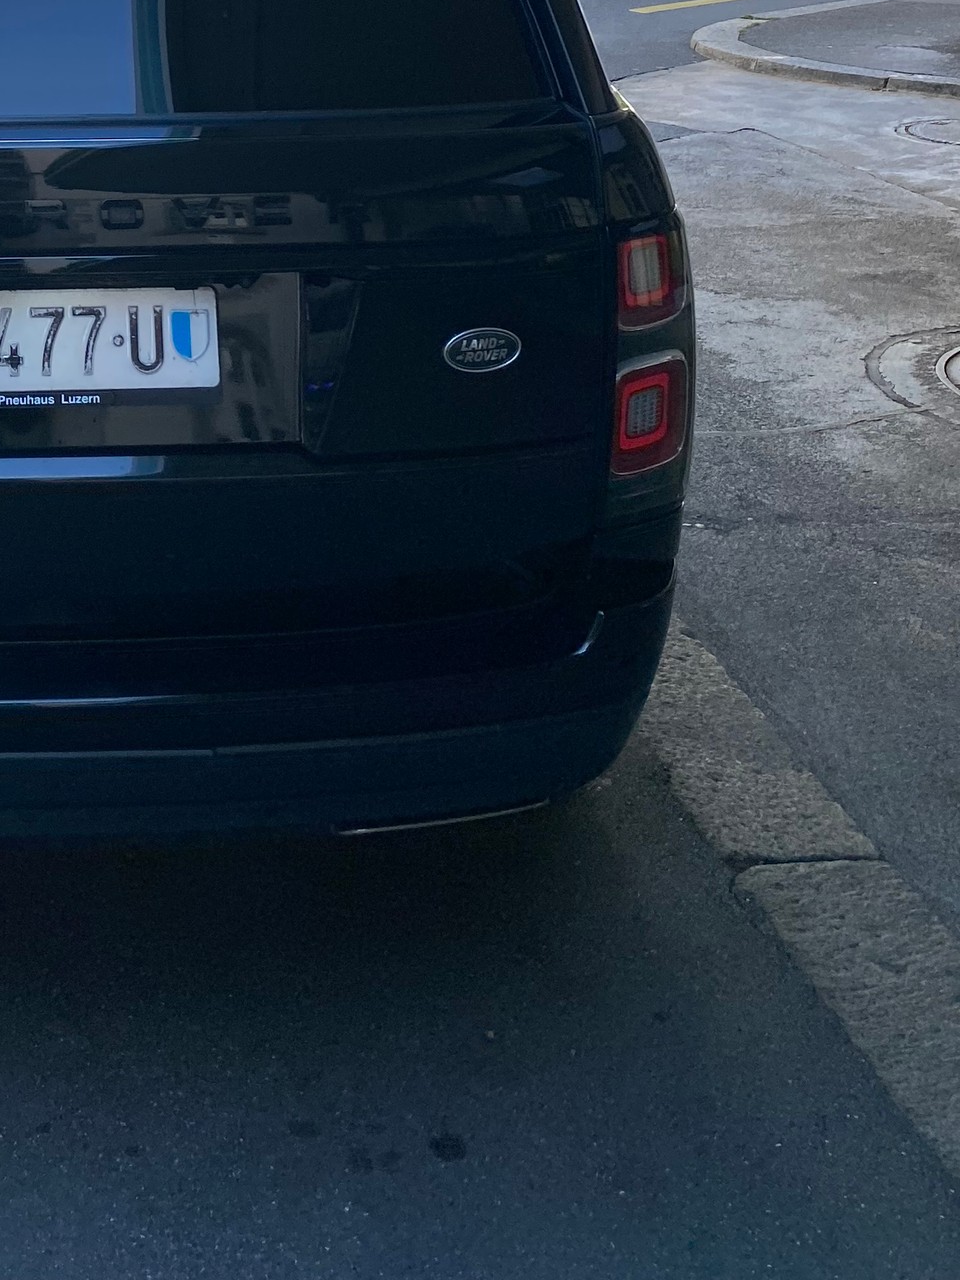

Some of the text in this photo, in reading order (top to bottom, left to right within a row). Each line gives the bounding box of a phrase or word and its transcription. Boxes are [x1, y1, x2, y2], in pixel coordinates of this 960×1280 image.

[461, 337, 497, 352] LAND
[464, 349, 508, 363] ROVER
[61, 393, 101, 405] Luzern
